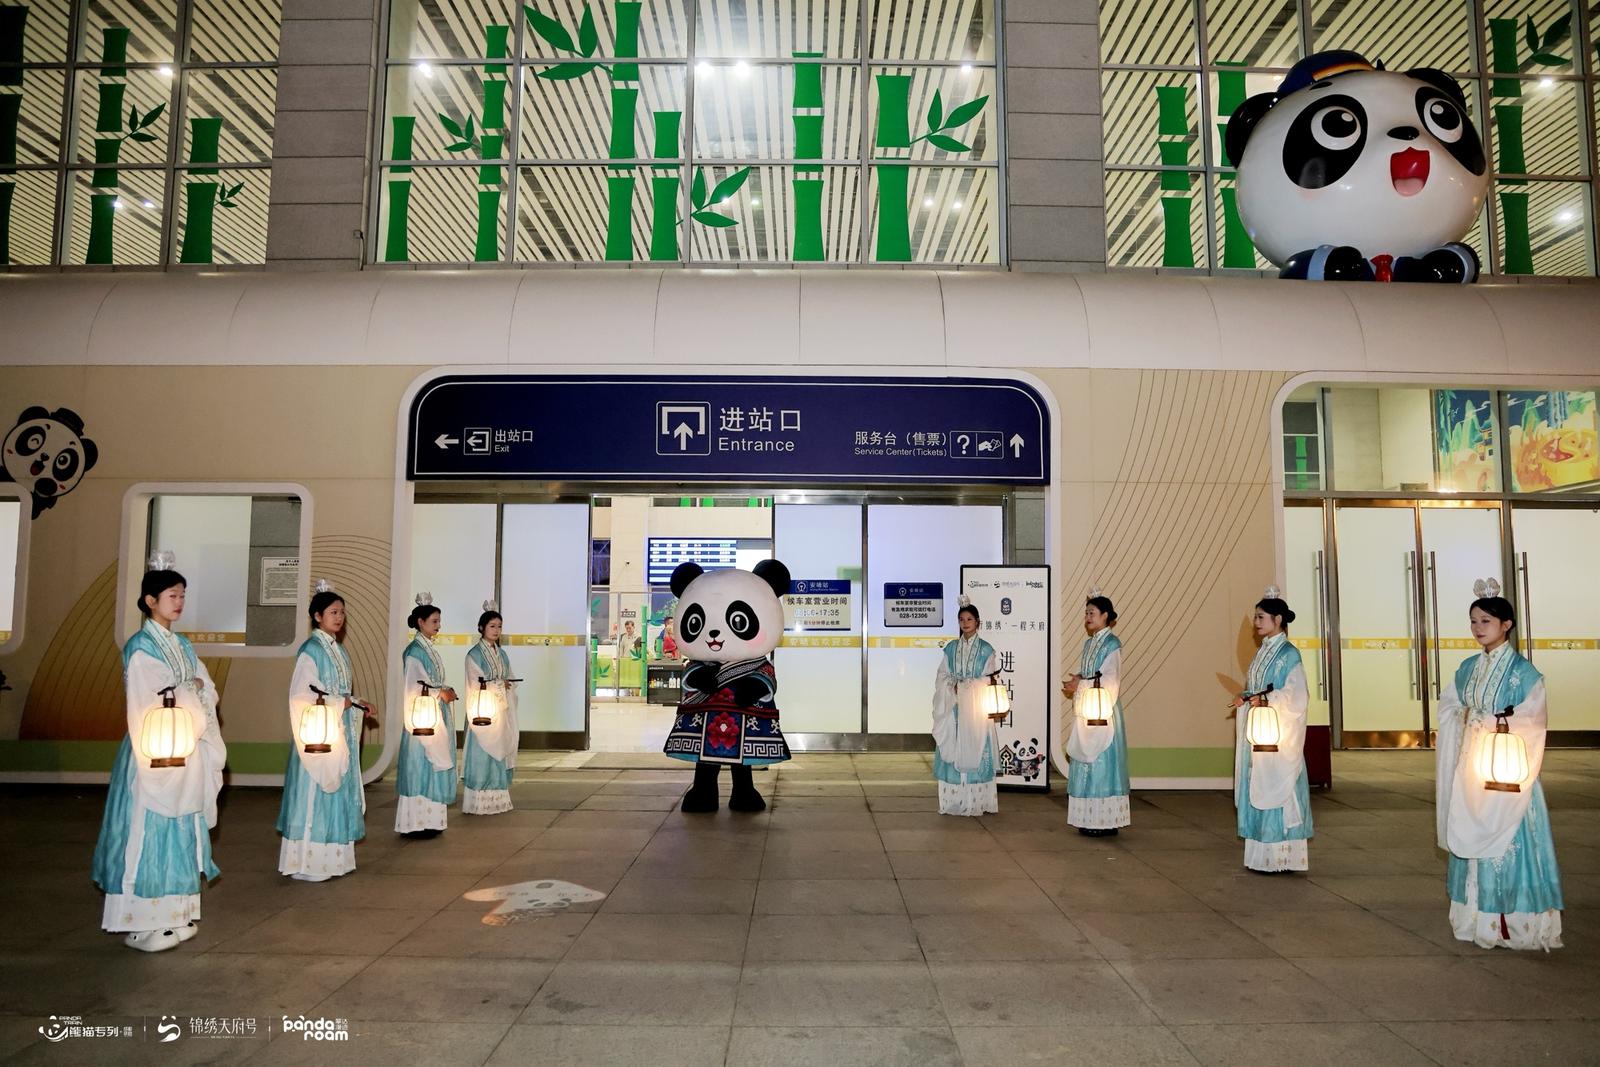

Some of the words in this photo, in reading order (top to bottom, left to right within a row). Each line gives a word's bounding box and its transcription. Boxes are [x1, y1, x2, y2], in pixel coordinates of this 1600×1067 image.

[719, 407, 801, 432] 进站口
[494, 429, 533, 443] 出站口
[494, 445, 510, 453] Exit
[718, 437, 795, 452] Entrance
[854, 447, 884, 456] Service
[886, 447, 947, 457] Center(Tickets)
